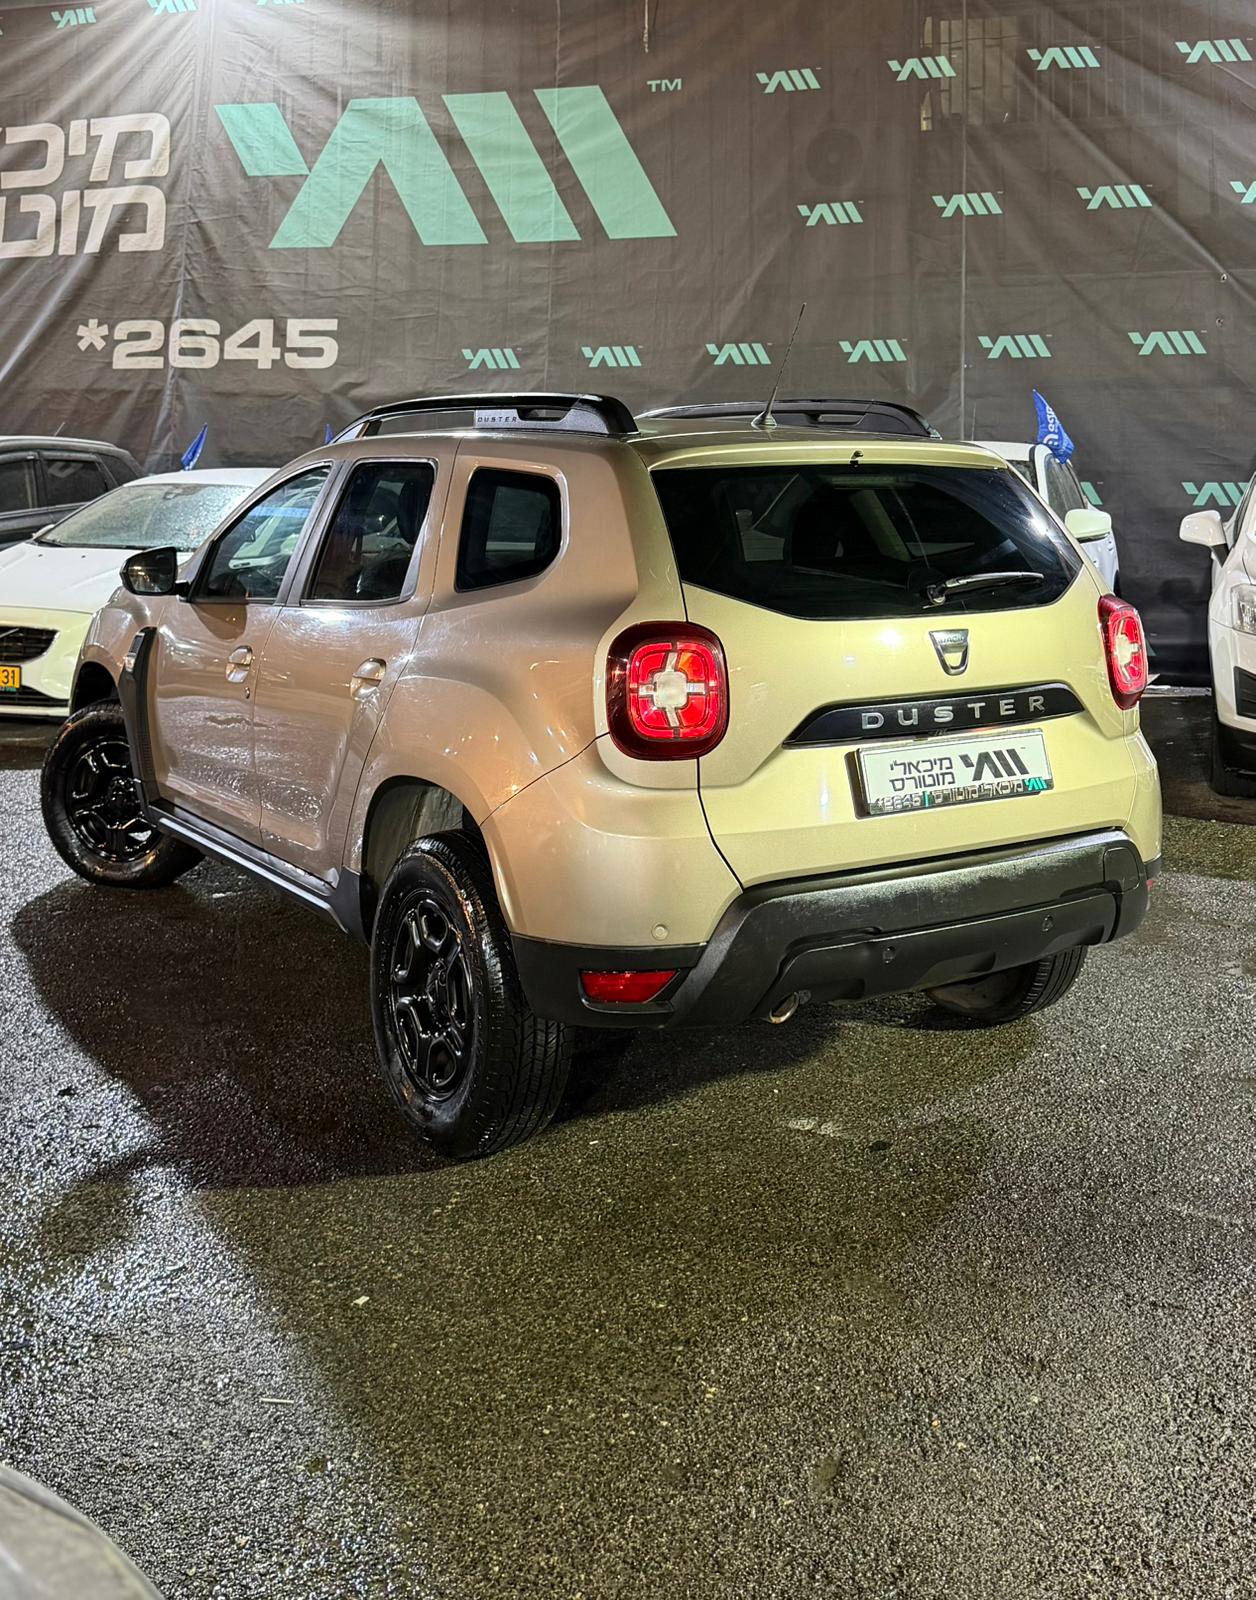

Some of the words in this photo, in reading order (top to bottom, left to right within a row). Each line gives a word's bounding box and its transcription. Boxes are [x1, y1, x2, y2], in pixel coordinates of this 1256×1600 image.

[646, 78, 682, 92] TM
[0, 112, 171, 189] מיכ
[861, 695, 1046, 730] DUSTER
[889, 757, 953, 776] מיכאלי
[889, 772, 956, 792] מוטורס
